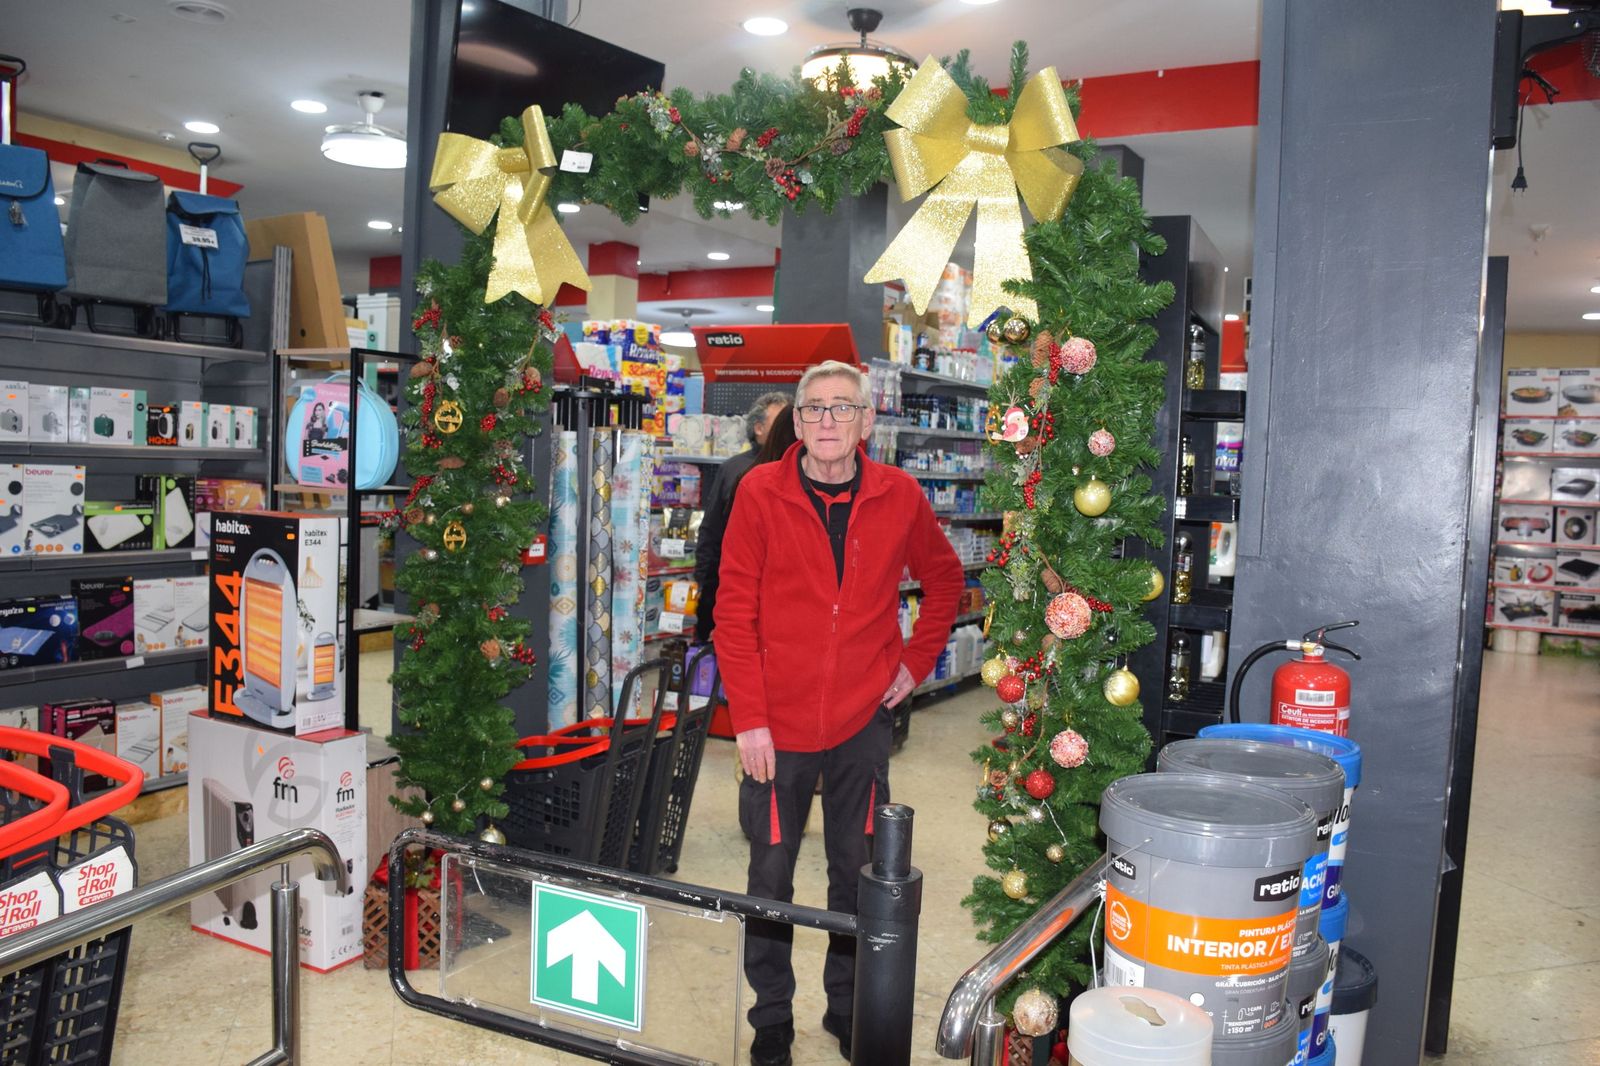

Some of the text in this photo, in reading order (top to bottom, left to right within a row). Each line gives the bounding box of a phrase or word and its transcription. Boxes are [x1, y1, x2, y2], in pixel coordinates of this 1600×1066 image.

[707, 333, 743, 345] ratio
[714, 368, 759, 376] herramientas
[25, 468, 54, 476] beurer
[215, 518, 251, 536] habitex
[304, 529, 329, 537] habitex
[215, 544, 236, 554] 1200 W
[304, 538, 322, 547] E344
[80, 582, 105, 590] beurer
[214, 570, 244, 717] E344
[273, 778, 298, 803] fm
[336, 787, 354, 803] fm
[78, 862, 115, 880] Shop
[89, 872, 118, 894] Roll
[1259, 875, 1300, 897] ratio
[0, 889, 38, 909] Shop
[82, 891, 111, 904] araven
[9, 900, 42, 924] Roll
[2, 920, 35, 936] araven
[1239, 926, 1276, 937] PINTURA
[1167, 934, 1268, 958] INTERIOR
[1221, 962, 1240, 970] TINTA
[1235, 978, 1266, 987] CUBRICIÓN
